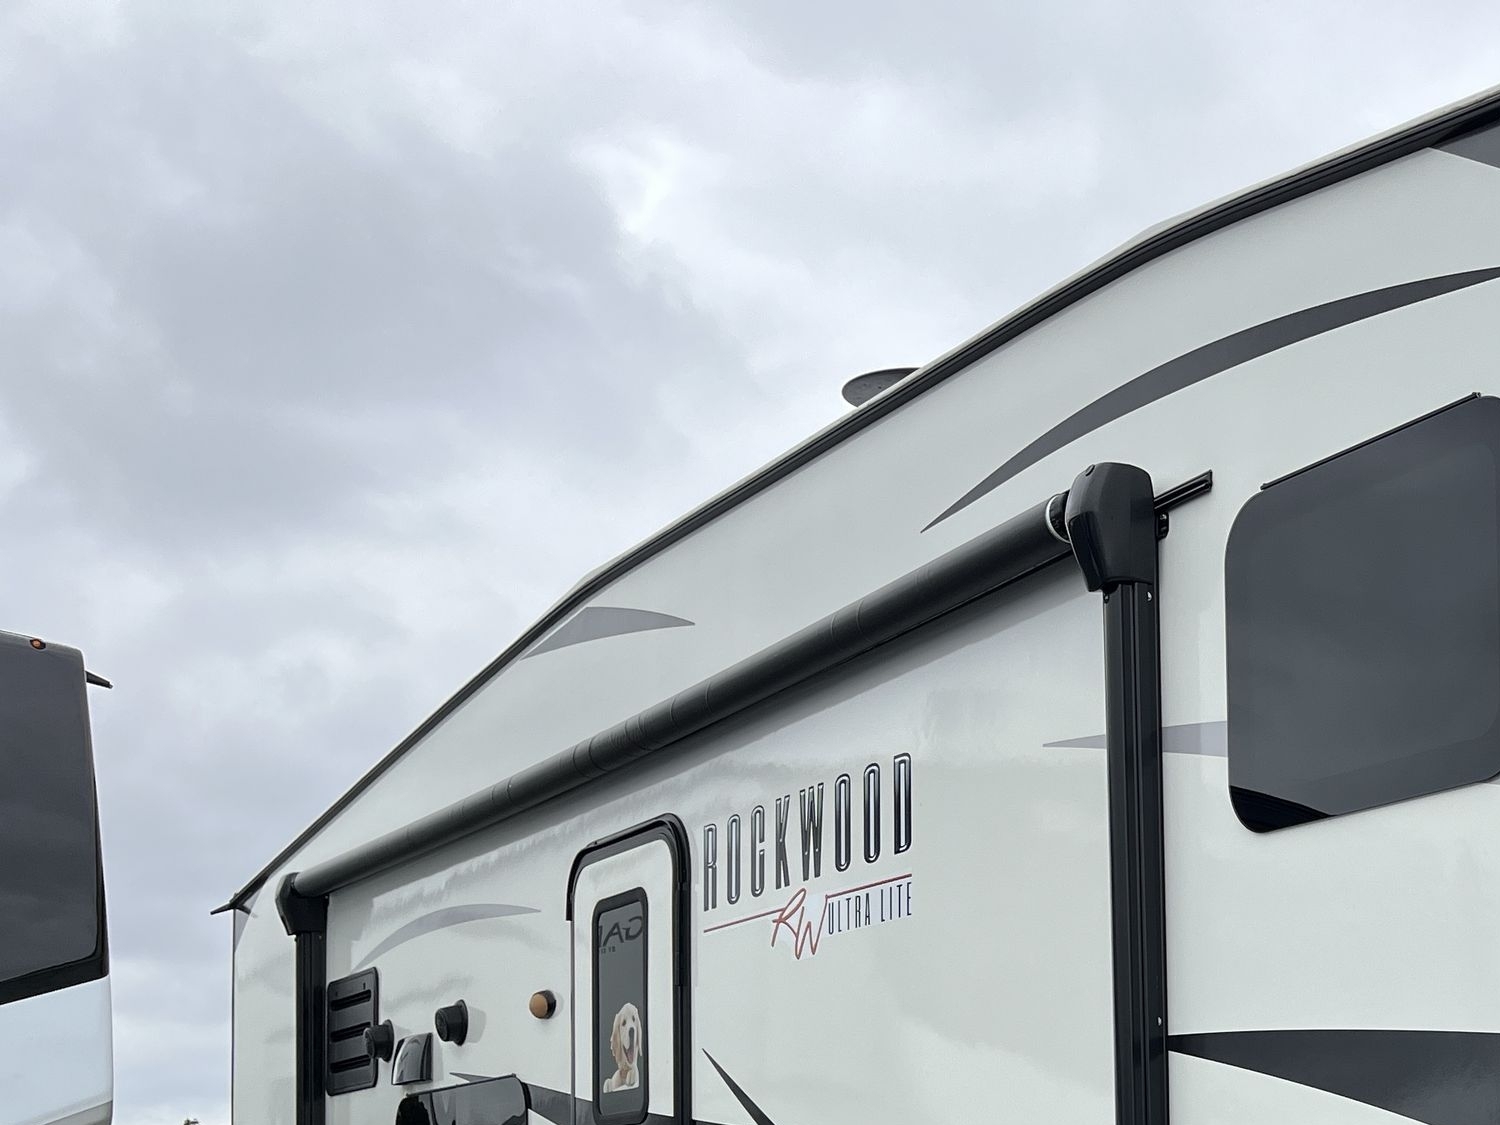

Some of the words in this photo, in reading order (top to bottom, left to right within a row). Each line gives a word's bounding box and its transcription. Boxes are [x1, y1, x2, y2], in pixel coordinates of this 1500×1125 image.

[703, 752, 912, 912] ROCKWOOD
[771, 888, 828, 960] RW
[828, 892, 871, 935] ULTRA
[880, 882, 912, 922] LITE
